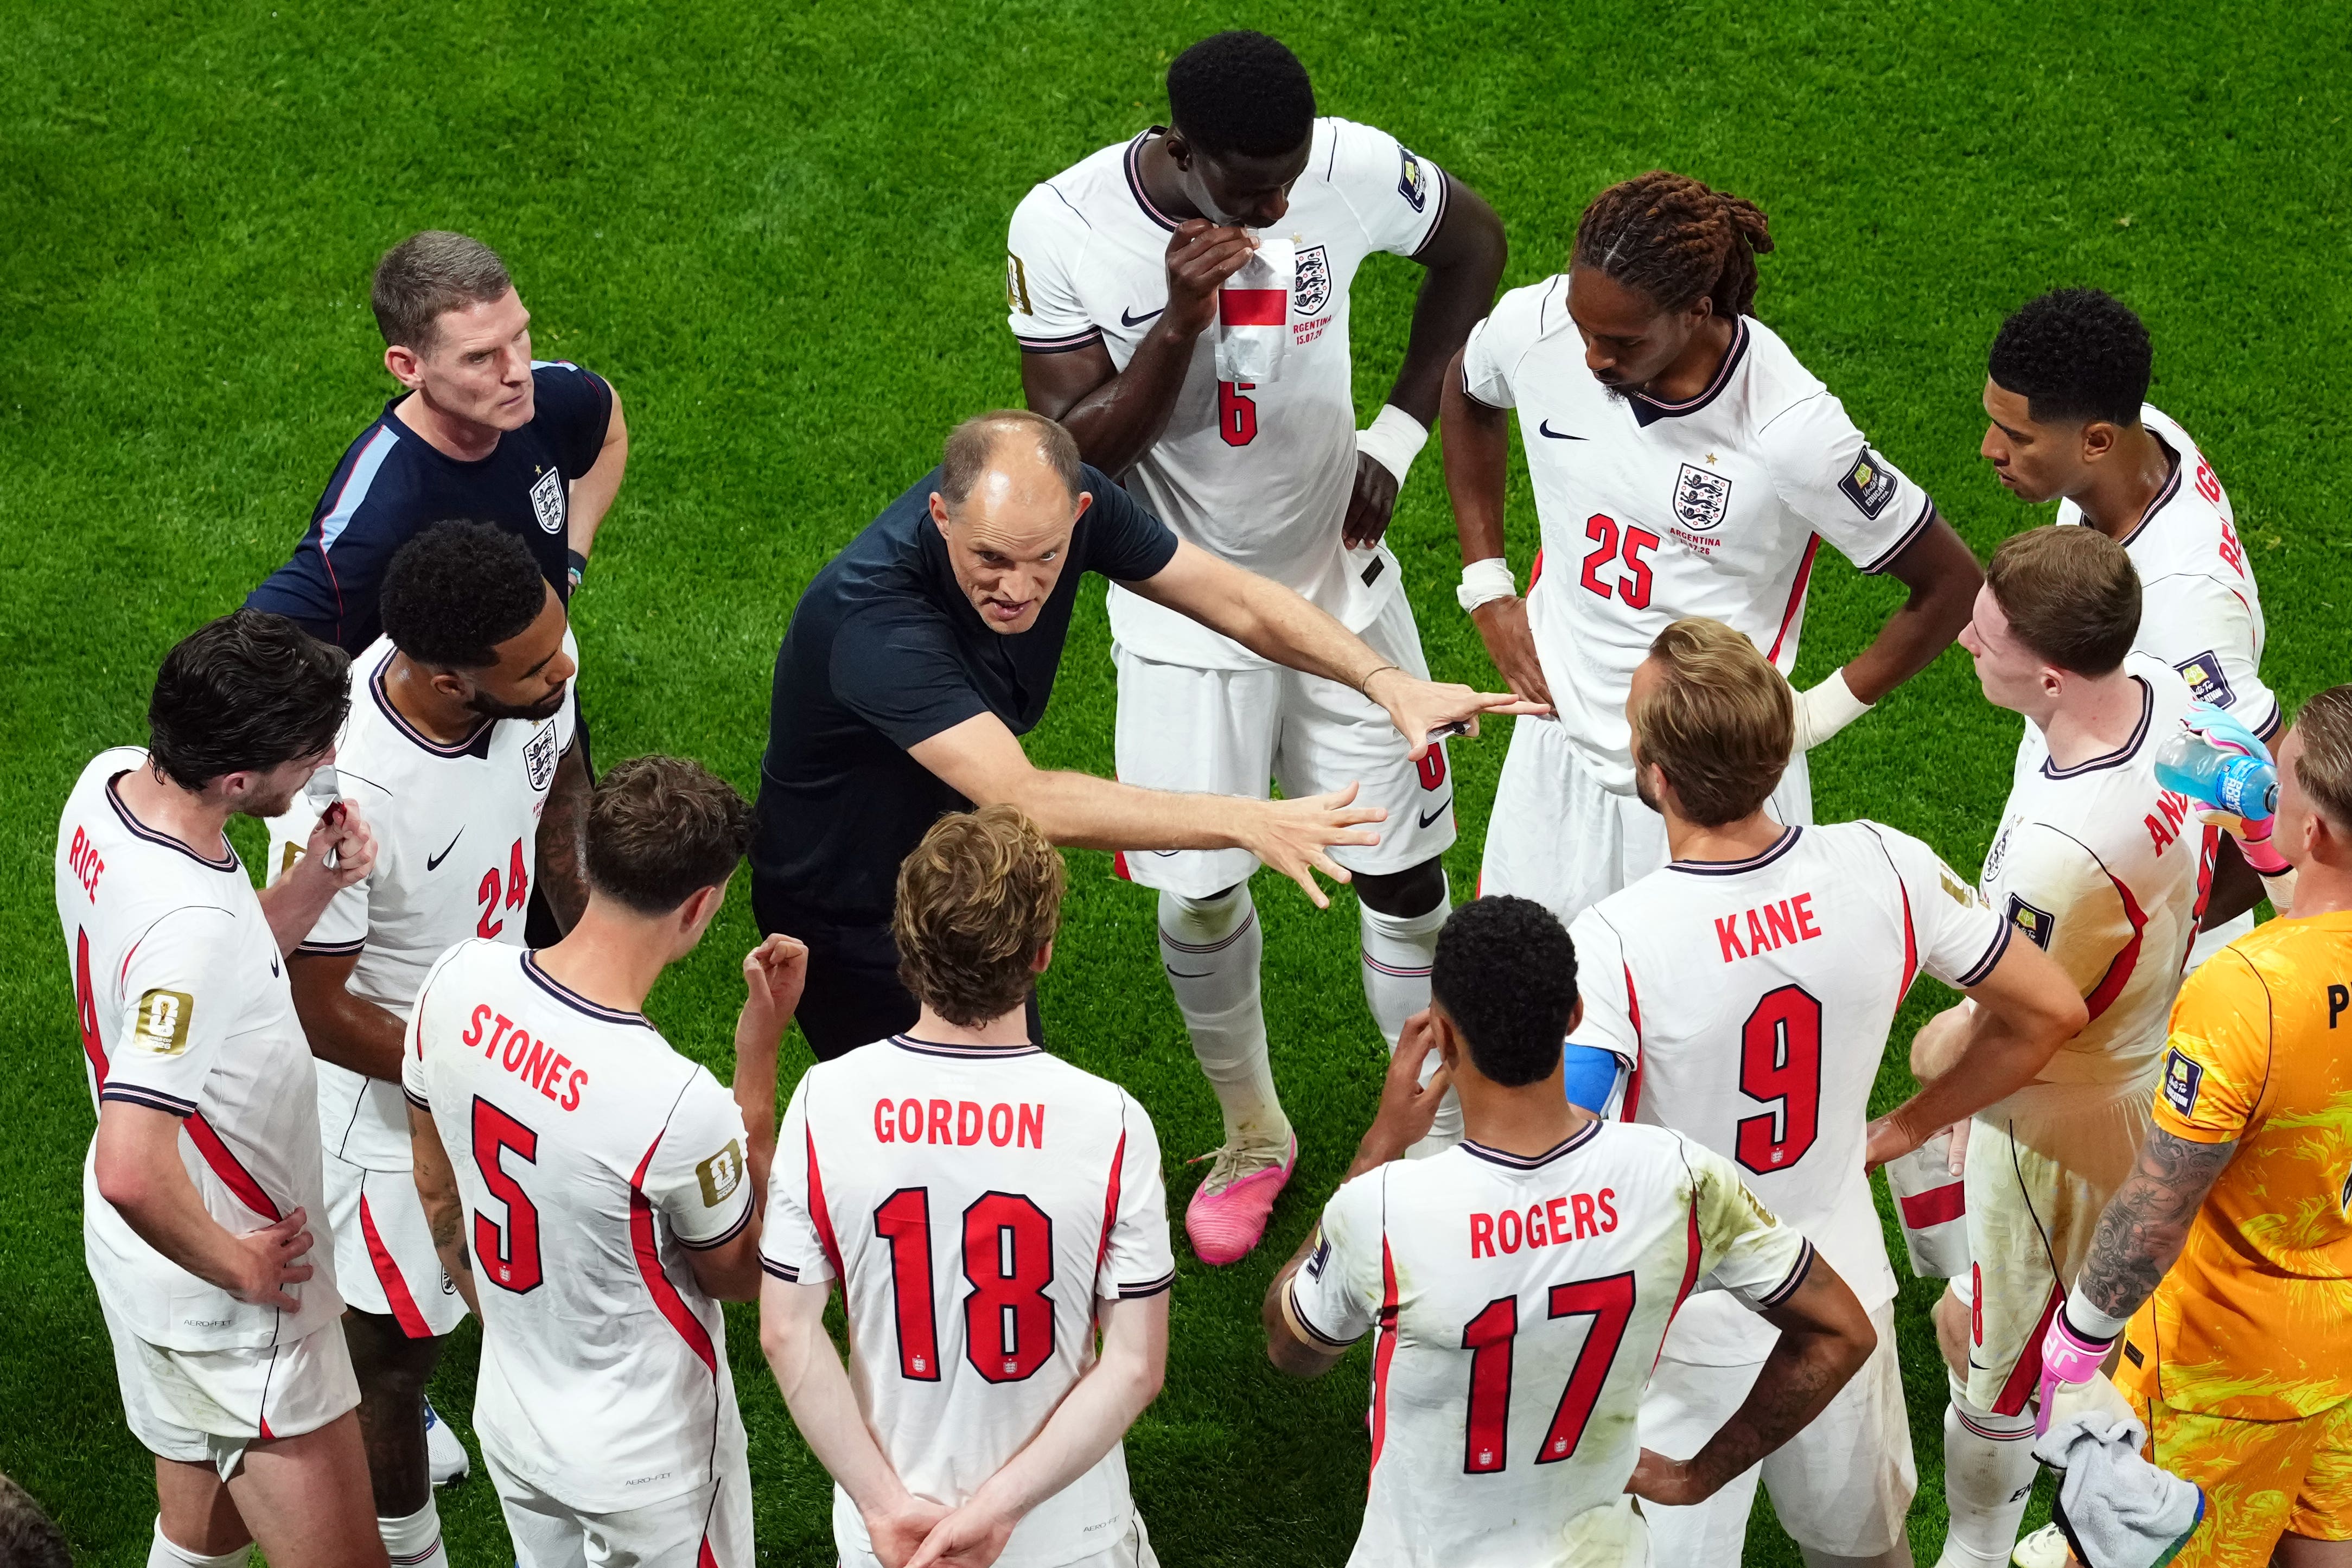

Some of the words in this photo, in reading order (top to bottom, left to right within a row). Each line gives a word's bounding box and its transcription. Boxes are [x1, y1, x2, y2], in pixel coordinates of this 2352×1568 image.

[1293, 315, 1331, 334] RGENTINA
[1218, 378, 1258, 447] 6
[1865, 475, 1888, 507] EDUCATION
[1878, 490, 1889, 502] FIFA
[1580, 513, 1661, 611] 25
[1670, 527, 1720, 546] ARGENTINA
[2202, 680, 2214, 692] For
[69, 824, 105, 907] RICE
[477, 837, 529, 940] 24
[1714, 891, 1822, 964] KANE
[77, 922, 110, 1110] 4
[2327, 981, 2352, 1029] P
[462, 1004, 589, 1112] STONES
[1736, 983, 1822, 1176] 9
[874, 1098, 1045, 1150] GORDON
[473, 1094, 543, 1295] 5
[1470, 1187, 1619, 1259] ROGERS
[874, 1186, 1055, 1384] 18
[1972, 1260, 1983, 1348] 8
[1461, 1270, 1636, 1475] 17
[626, 1472, 672, 1486] AERO-FIT
